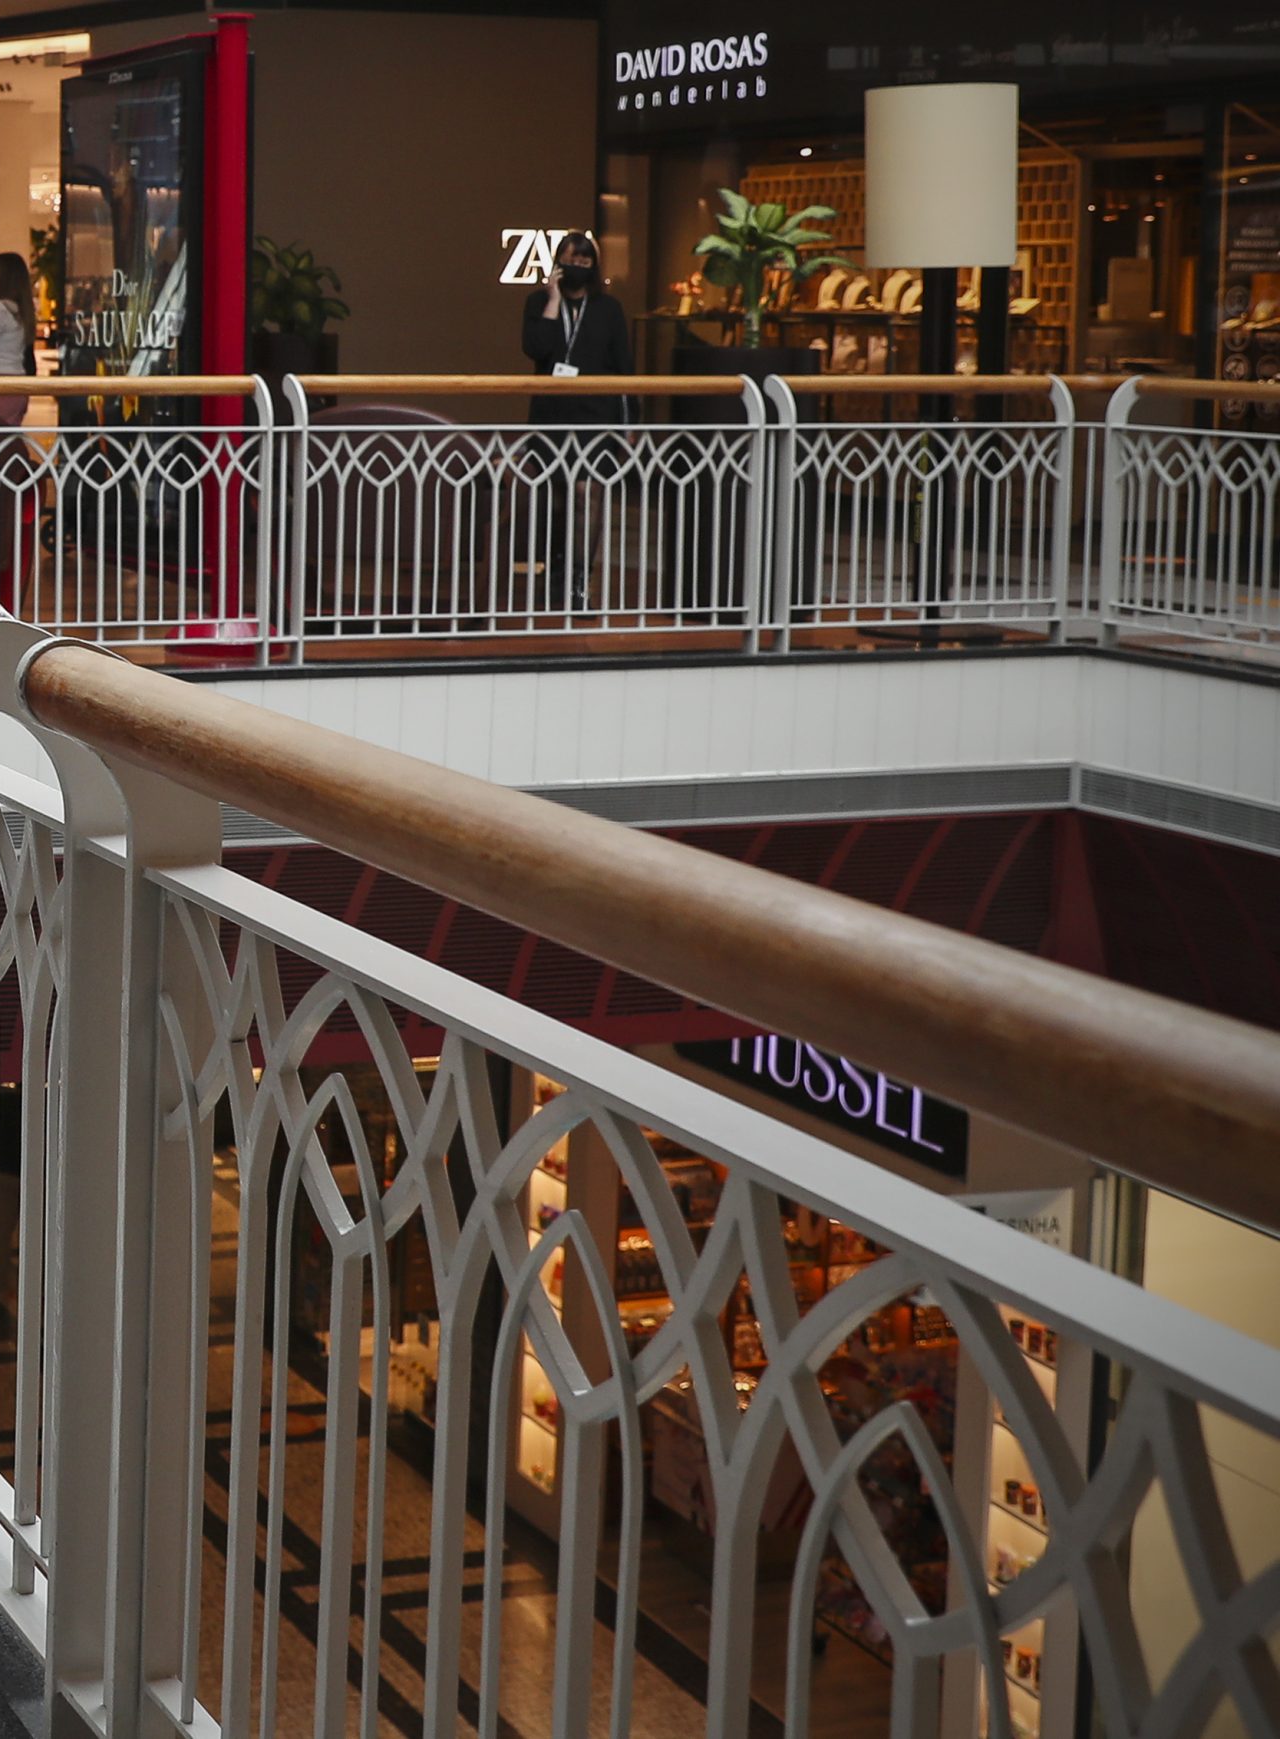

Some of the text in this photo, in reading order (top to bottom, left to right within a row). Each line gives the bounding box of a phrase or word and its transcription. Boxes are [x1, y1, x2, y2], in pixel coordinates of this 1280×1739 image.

[616, 32, 768, 82] DAVID ROSAS
[617, 75, 767, 111] wonderlab
[111, 268, 139, 297] Dior
[75, 310, 177, 349] SAUVAGE
